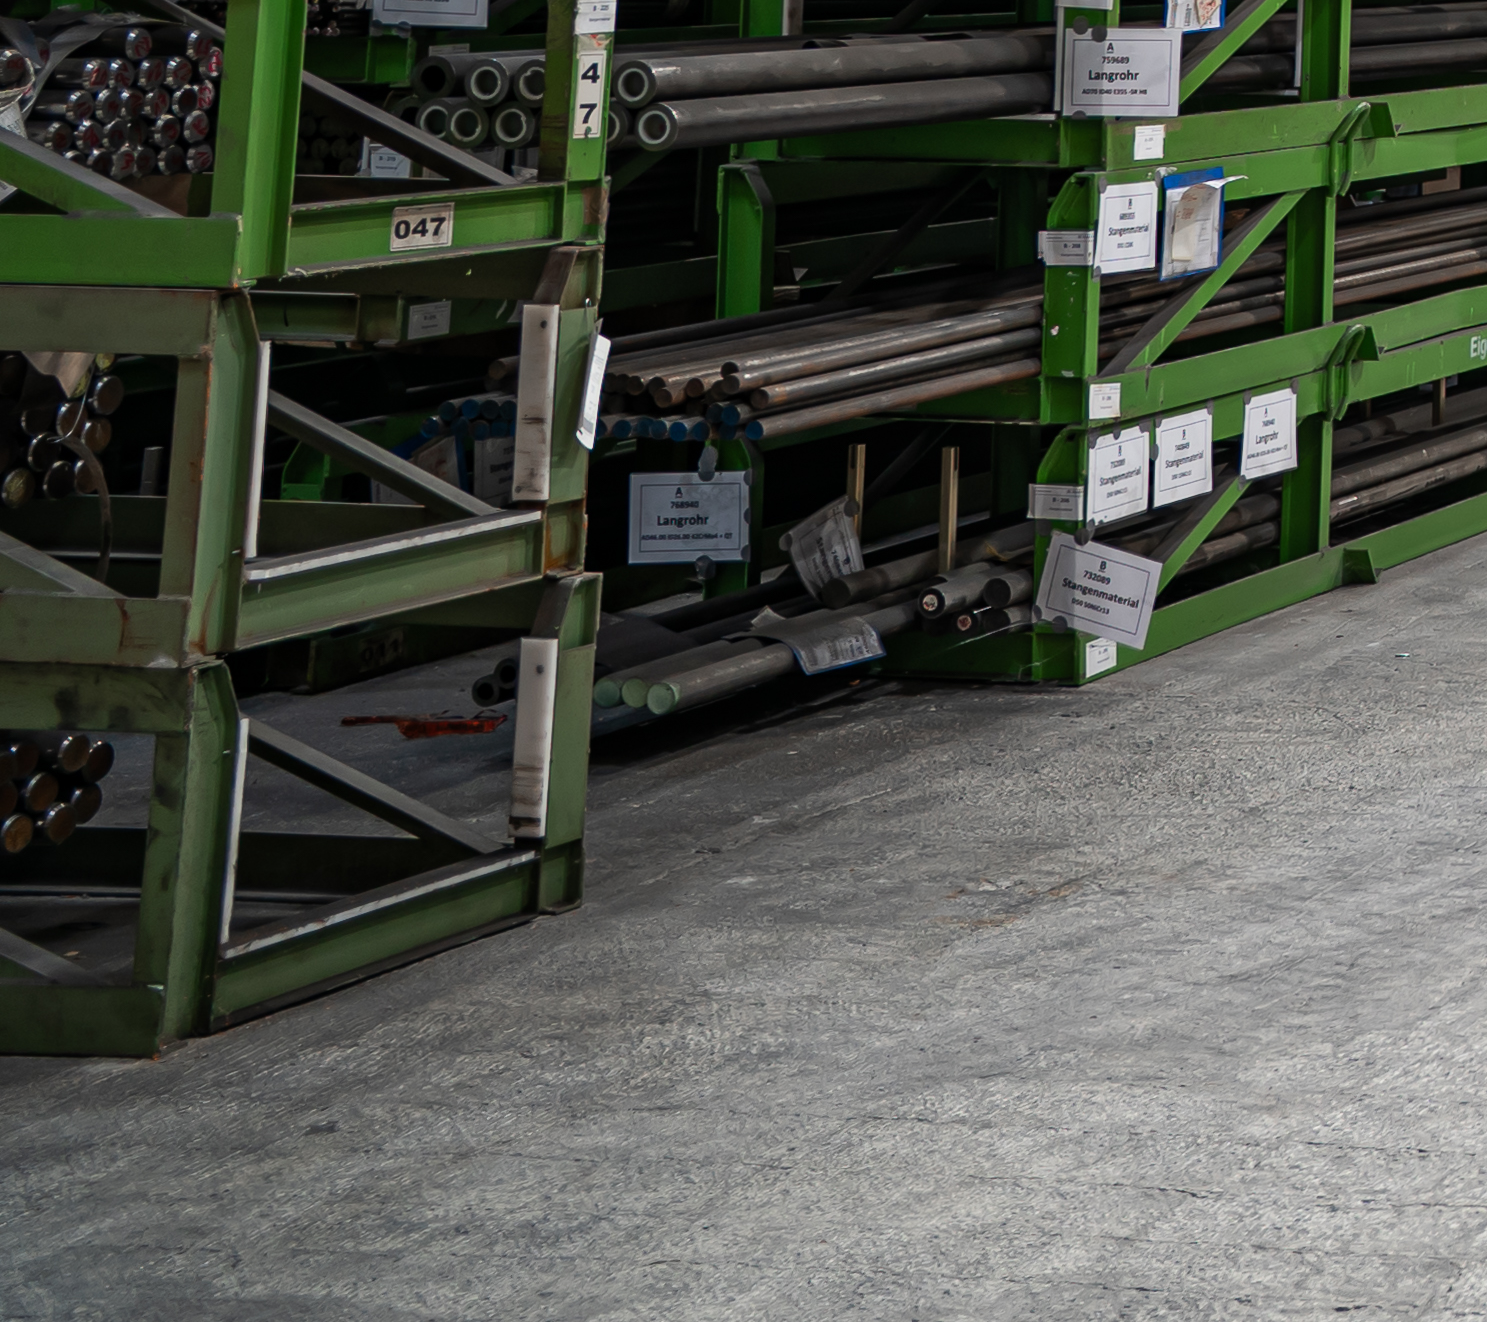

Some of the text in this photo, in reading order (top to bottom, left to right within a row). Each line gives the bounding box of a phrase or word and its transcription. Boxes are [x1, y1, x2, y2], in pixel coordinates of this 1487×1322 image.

[1106, 42, 1114, 52] A
[1101, 55, 1130, 65] 759689
[1088, 69, 1140, 83] Langrohr
[393, 216, 447, 240] 047
[1255, 429, 1279, 445] Langrohr
[1165, 449, 1204, 469] Stangenmaterial
[1099, 465, 1142, 487] Stangenmaterial
[675, 486, 684, 497] A
[656, 514, 709, 529] Langrohr
[1099, 560, 1107, 572] B
[1082, 569, 1111, 586] 732089
[1061, 576, 1140, 609] Stangenmaterial
